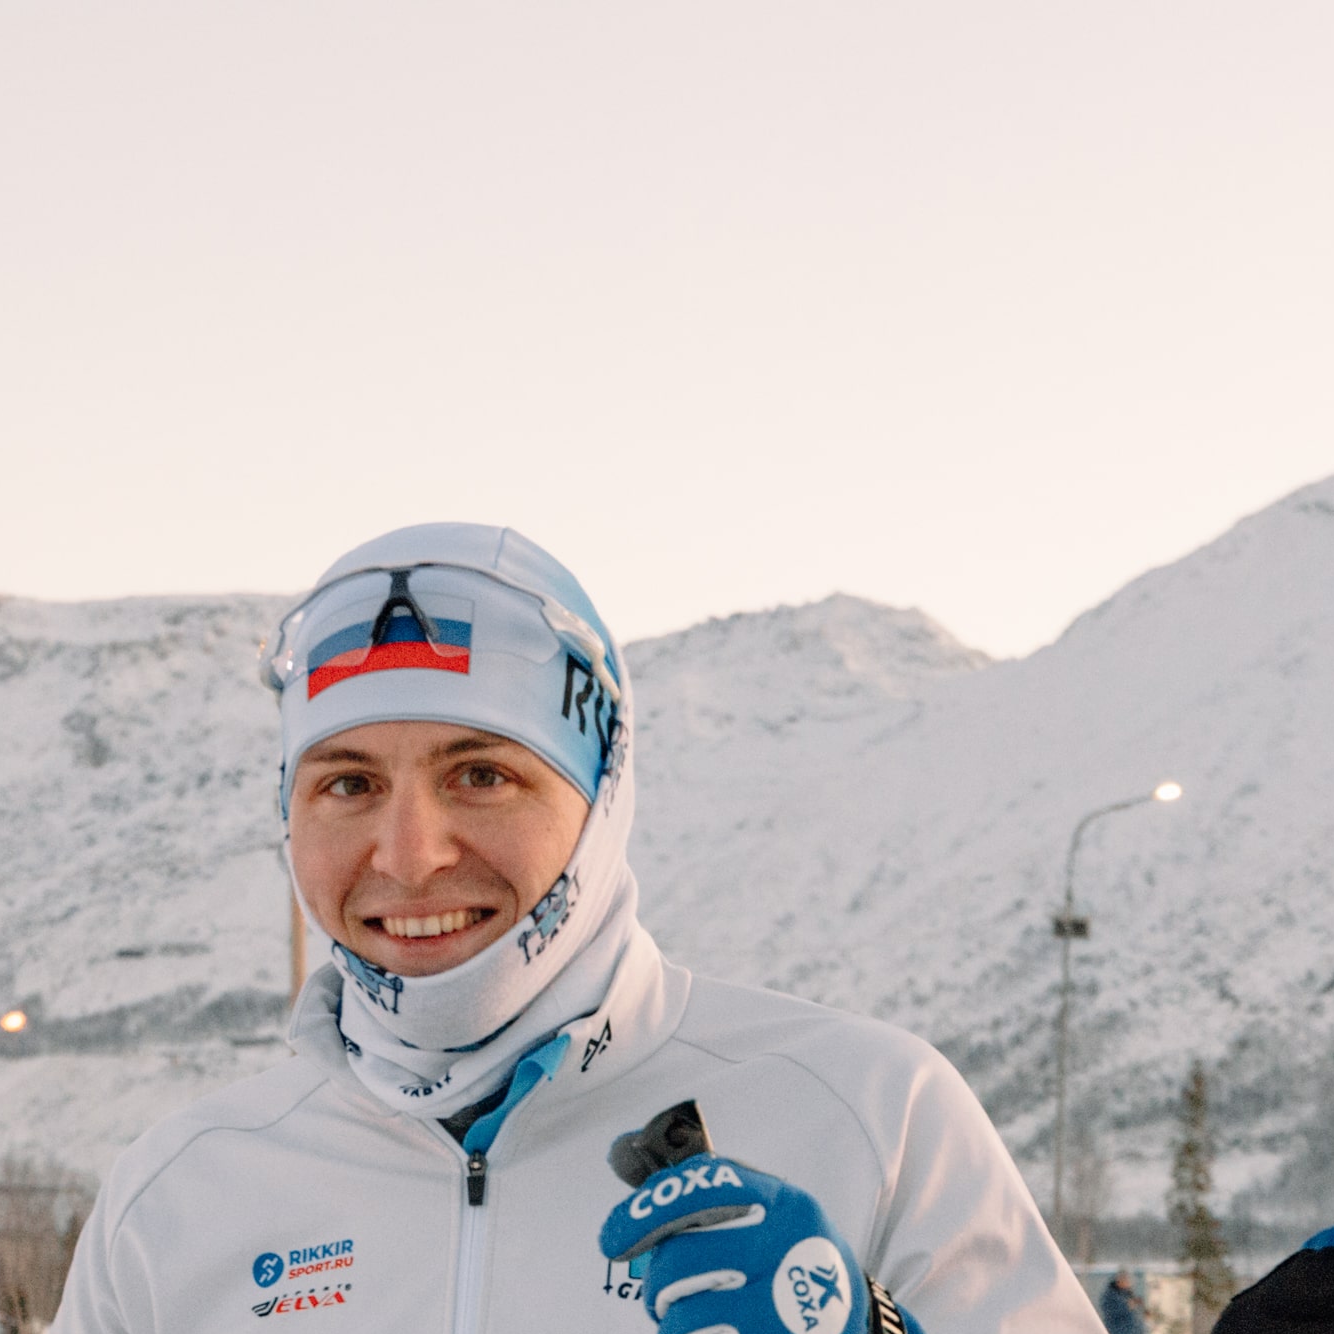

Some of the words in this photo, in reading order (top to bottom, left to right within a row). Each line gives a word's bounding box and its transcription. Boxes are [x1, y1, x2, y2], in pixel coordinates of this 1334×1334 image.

[629, 1165, 744, 1221] COXA
[288, 1239, 354, 1266] RIKKIR
[288, 1256, 354, 1280] SPORT.RU
[787, 1265, 819, 1333] COXA
